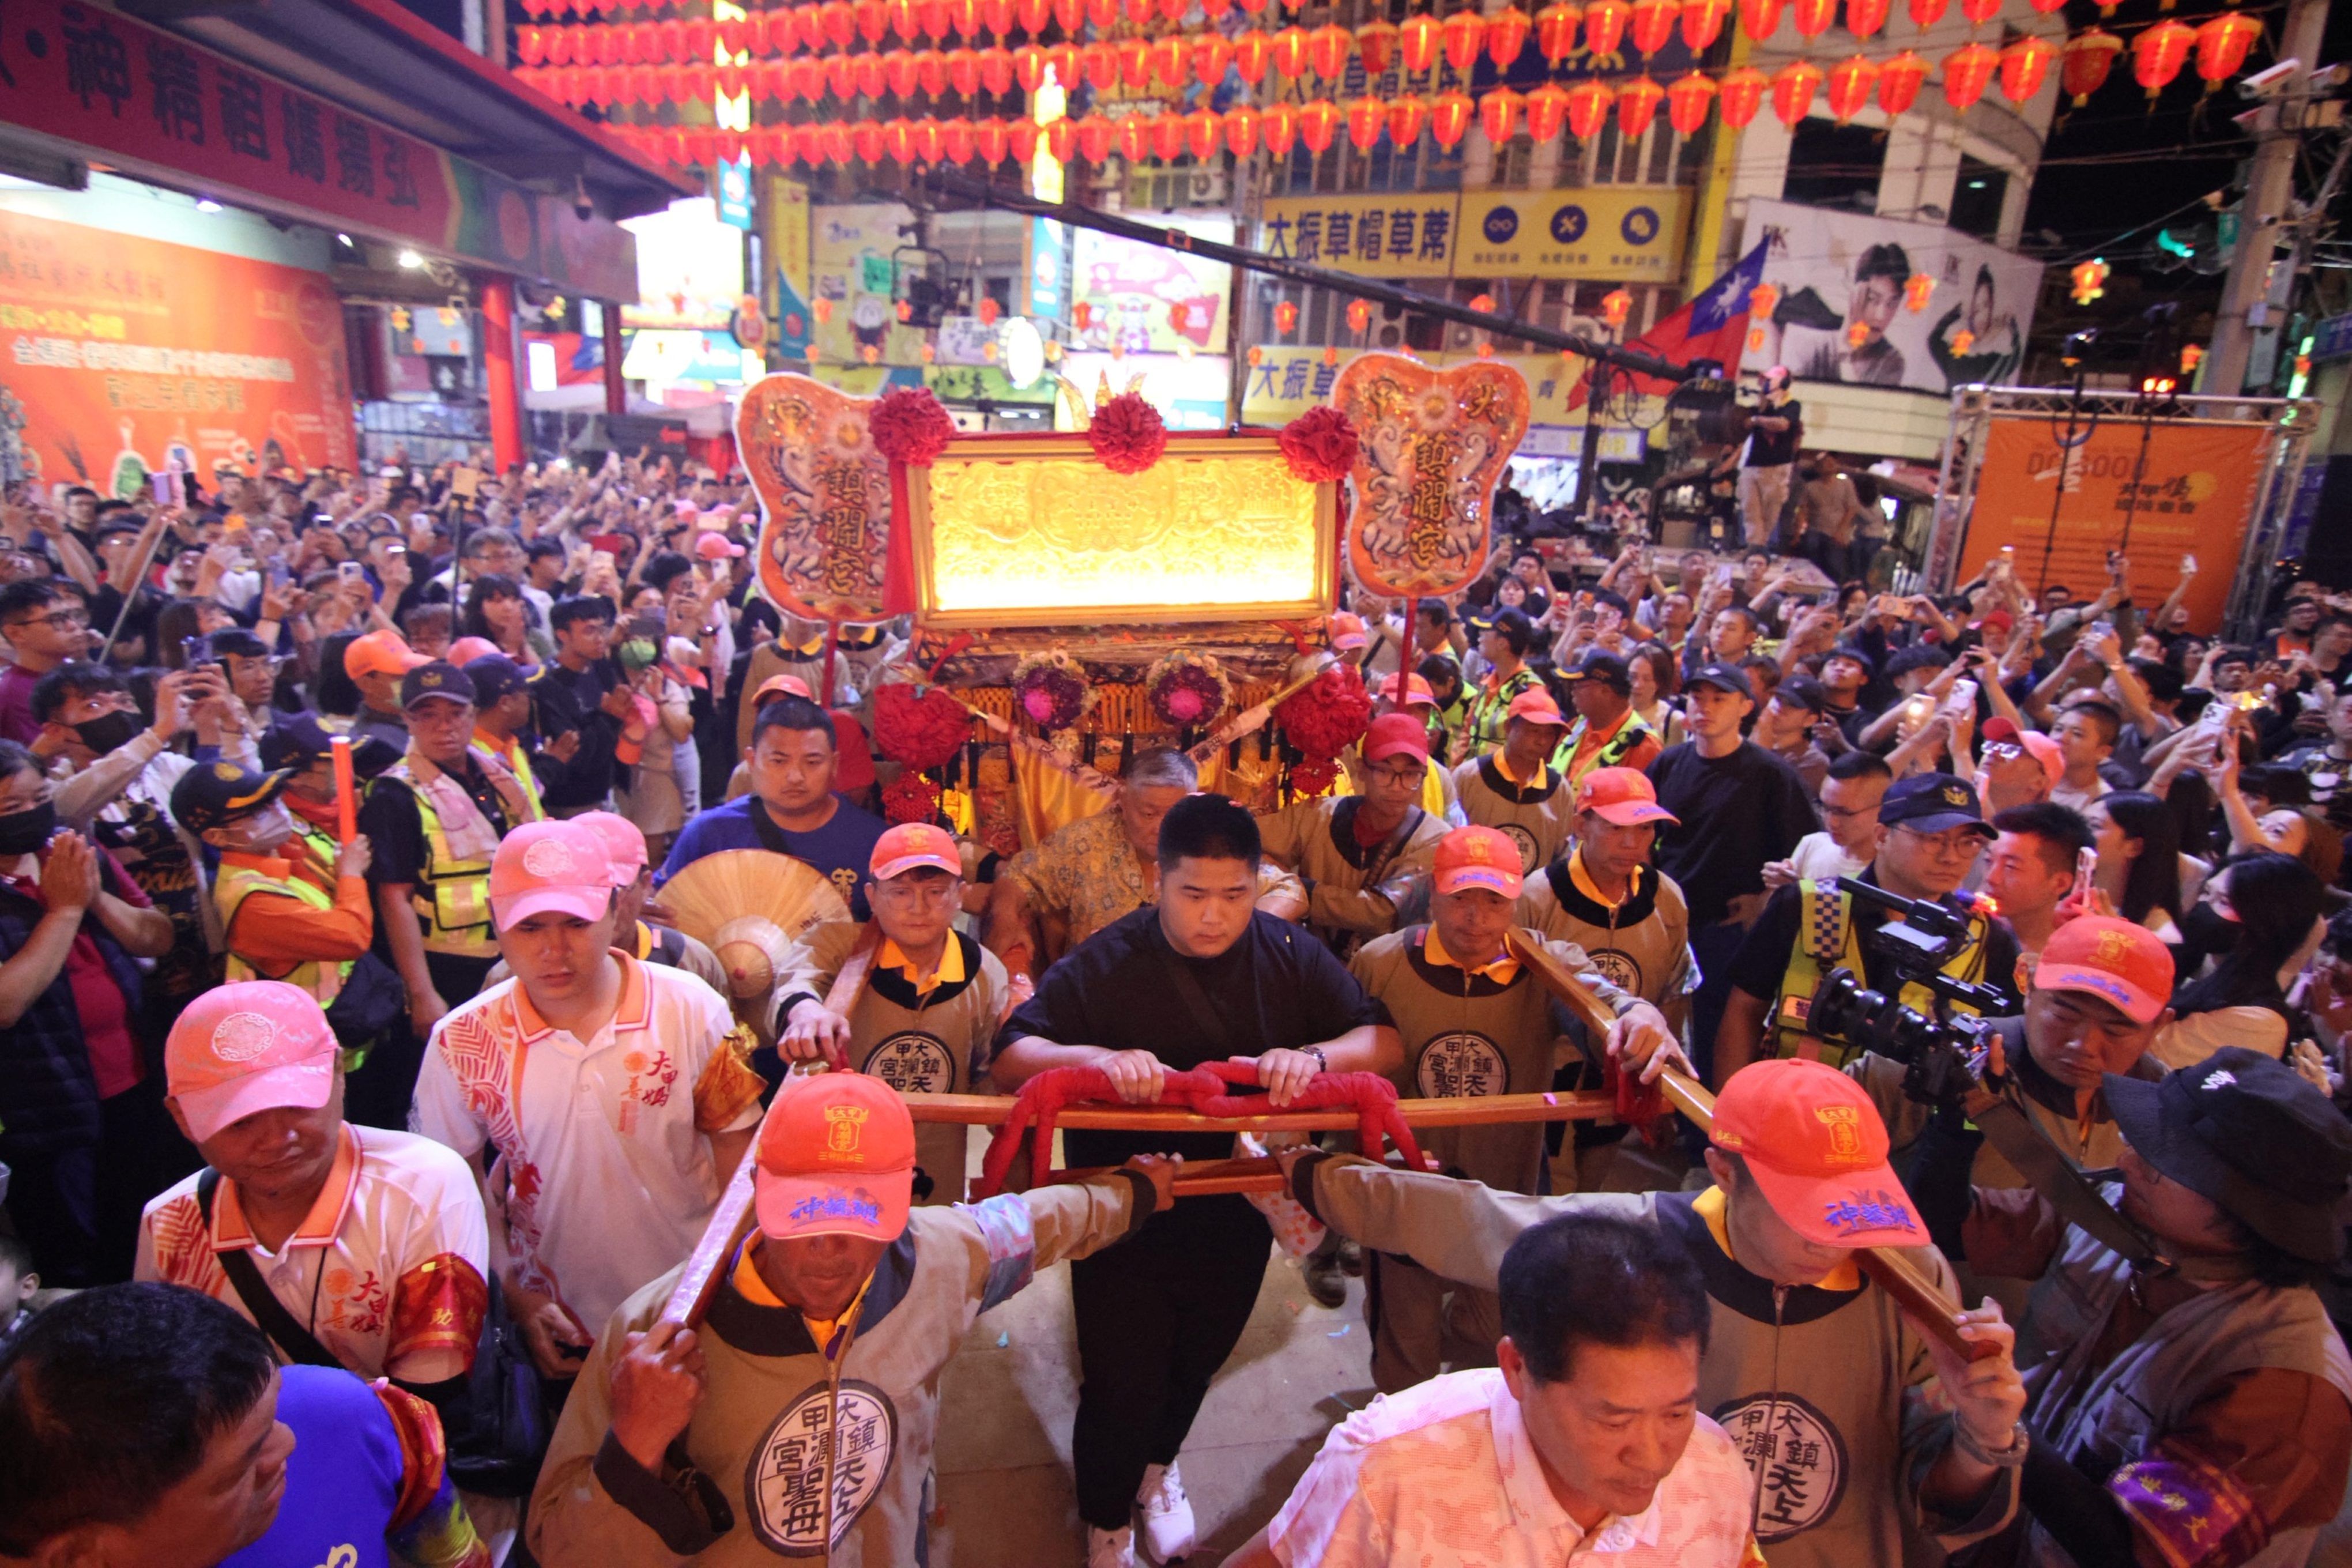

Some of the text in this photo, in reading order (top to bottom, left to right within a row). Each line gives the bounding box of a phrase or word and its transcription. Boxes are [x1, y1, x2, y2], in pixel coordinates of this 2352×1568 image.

[896, 1042, 929, 1058] 大甲
[1428, 1053, 1494, 1075] 鎮瀾宮
[1445, 1040, 1481, 1059] 大甲
[641, 1050, 679, 1107] 大甲媽
[880, 1057, 941, 1076] 鎮瀾宮
[801, 1397, 861, 1431] 大甲
[1742, 1408, 1803, 1437] 大甲
[772, 1419, 877, 1475] 鎮瀾宮
[1730, 1429, 1821, 1471] 鎮瀾
